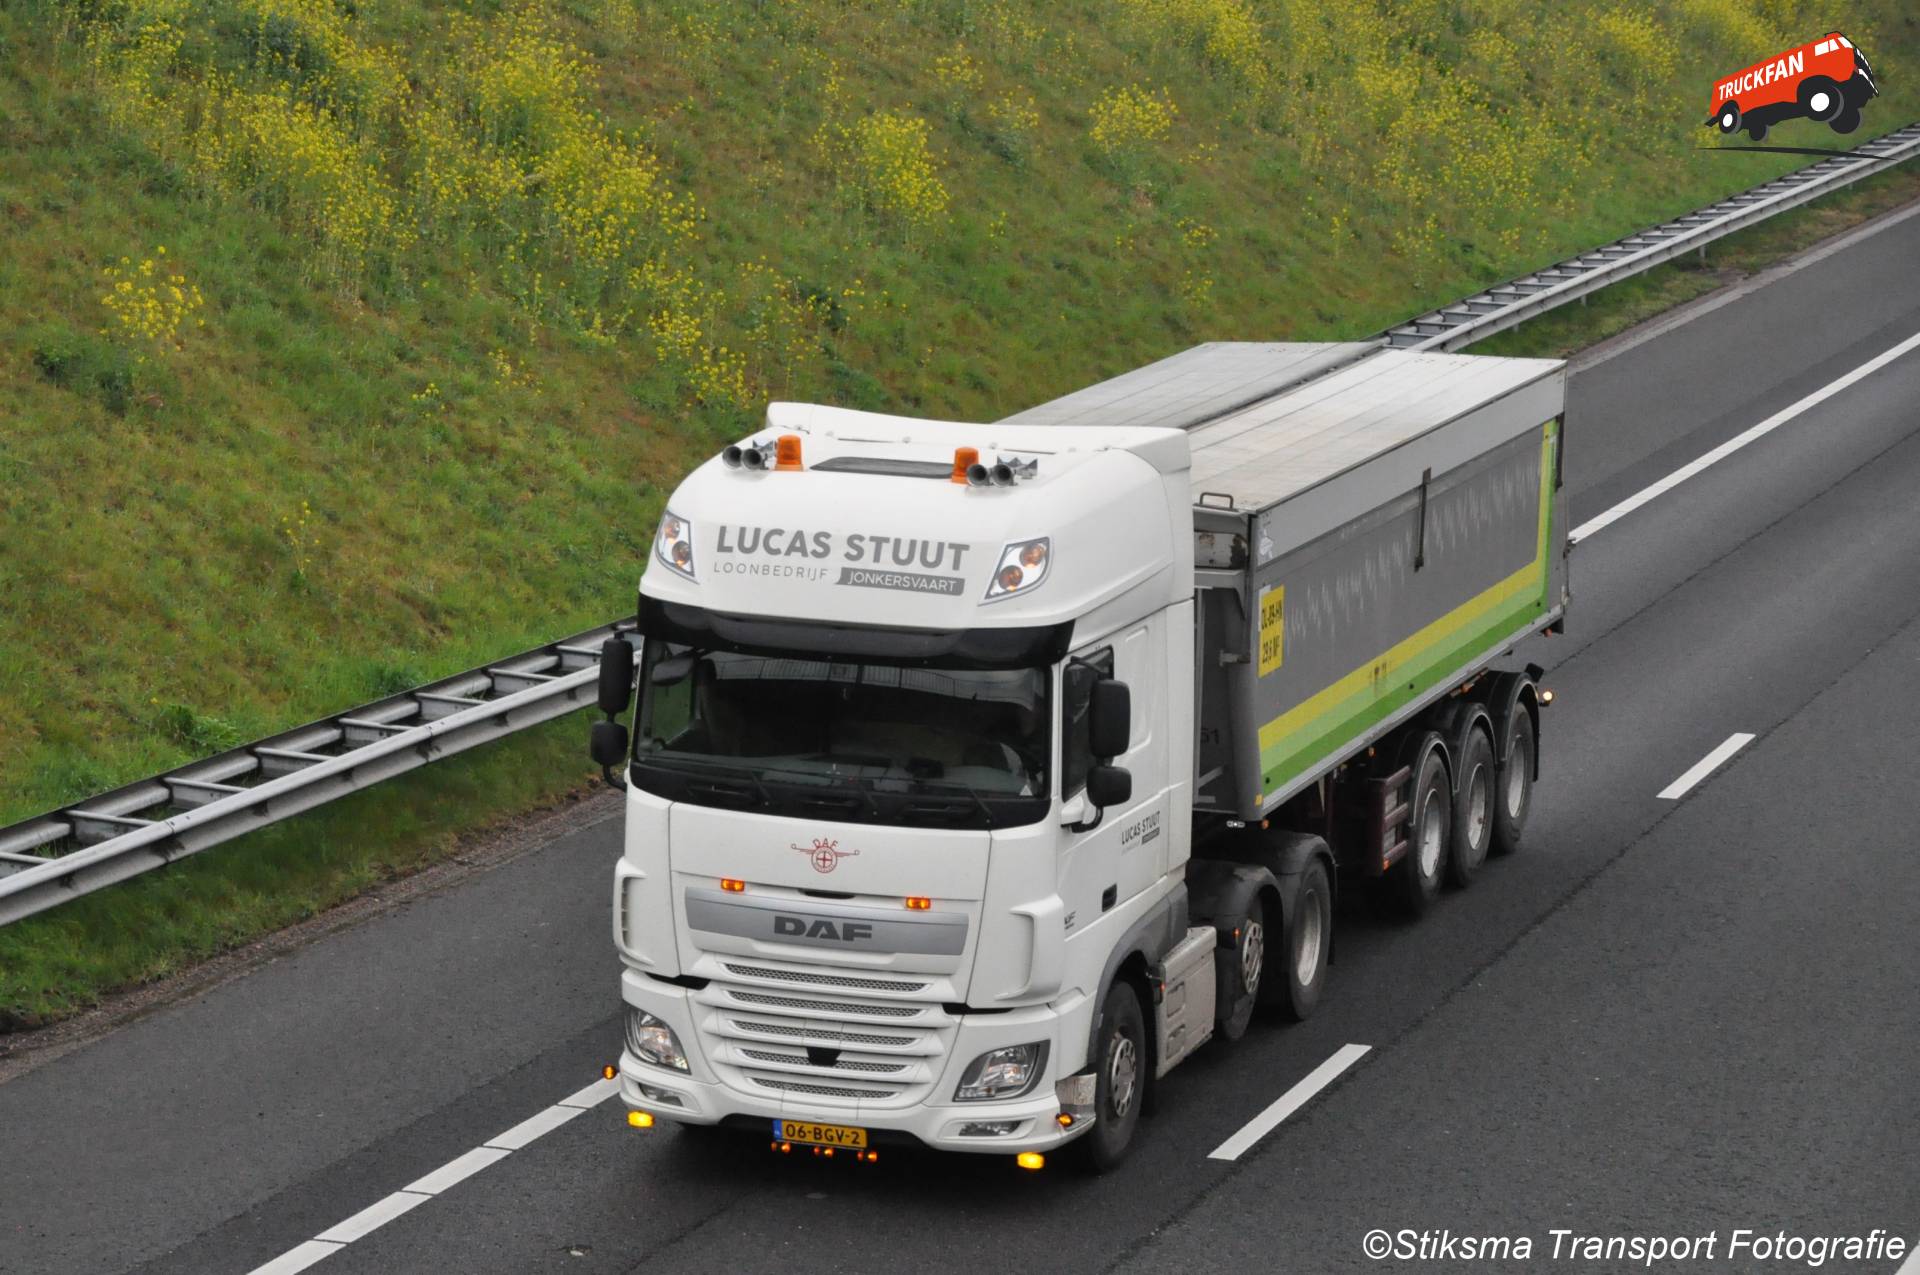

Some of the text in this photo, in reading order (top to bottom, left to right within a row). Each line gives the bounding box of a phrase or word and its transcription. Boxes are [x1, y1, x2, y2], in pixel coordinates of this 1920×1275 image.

[716, 525, 970, 571] LUCAS STUUT
[713, 561, 958, 593] LOONBEDRIJF JONKERSVAART
[1121, 823, 1141, 845] LUCAS
[1142, 811, 1160, 833] STUUT
[812, 837, 839, 849] DAF
[773, 915, 873, 942] DAF
[785, 1123, 860, 1145] 06-BGV-2
